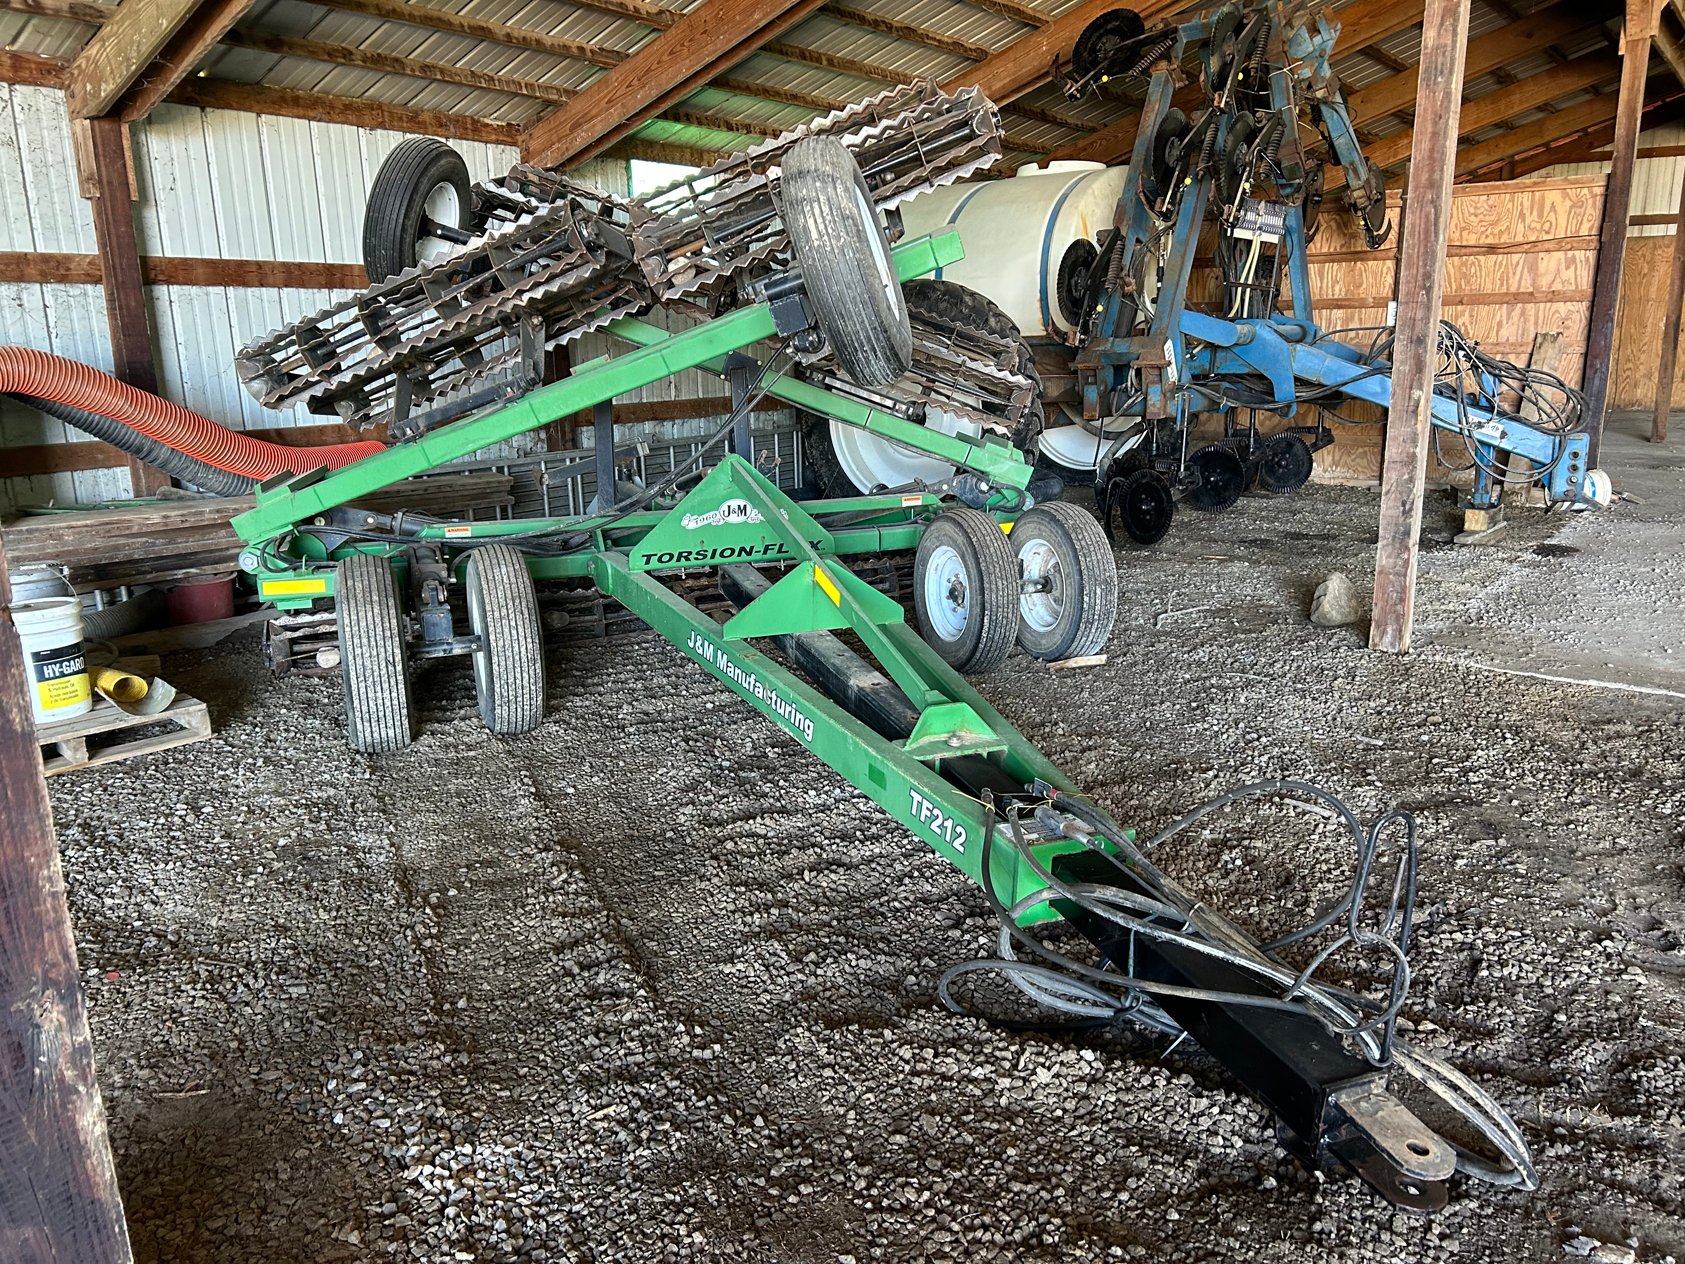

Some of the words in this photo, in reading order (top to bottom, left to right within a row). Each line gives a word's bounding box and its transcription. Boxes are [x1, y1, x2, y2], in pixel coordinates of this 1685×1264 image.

[722, 503, 748, 518] J&M
[641, 540, 824, 565] TORSION-FLX
[687, 629, 714, 663] J&M
[43, 656, 85, 679] HY-GARD
[909, 786, 967, 856] TF212
